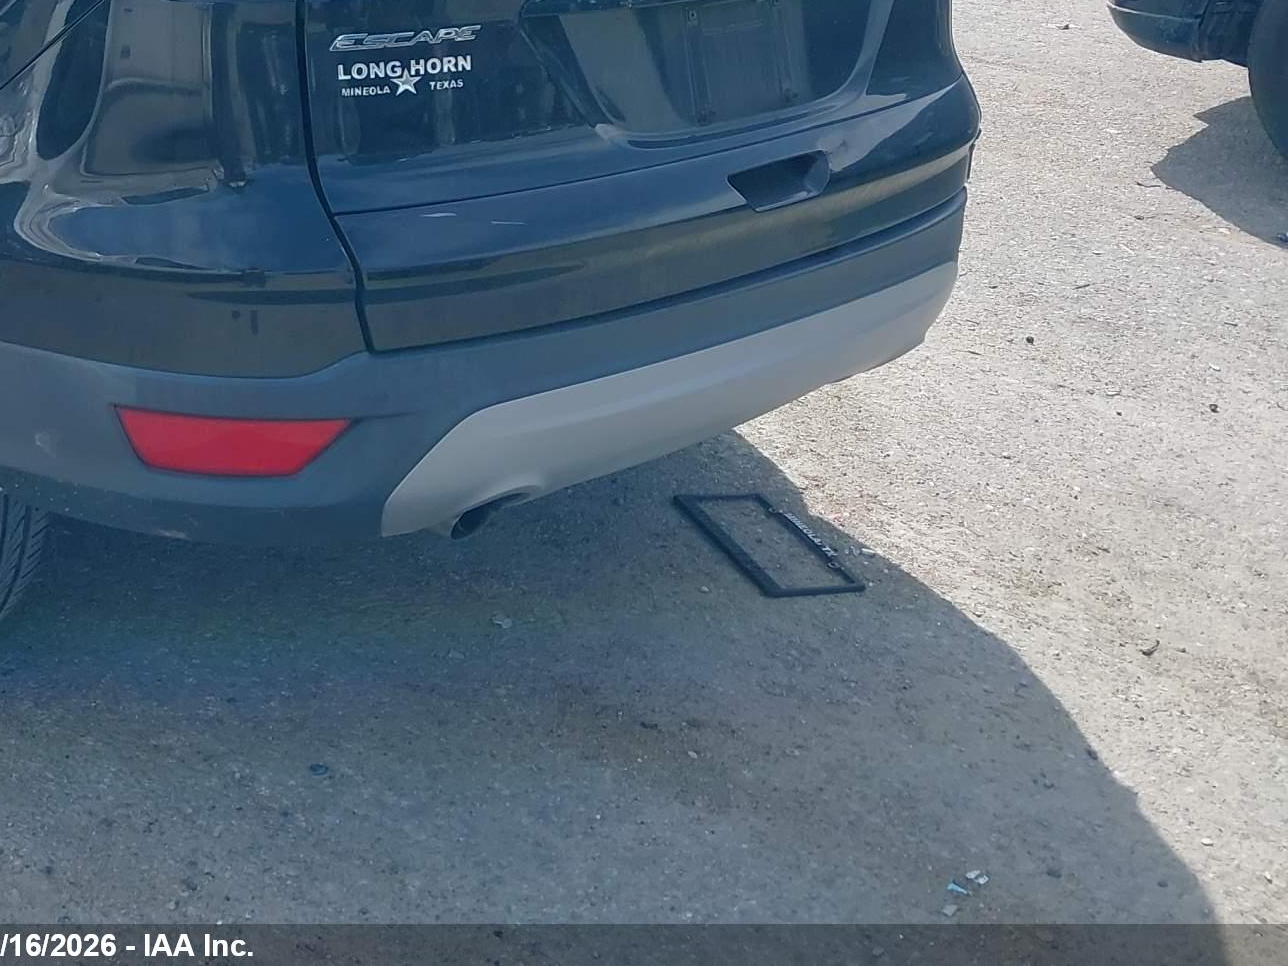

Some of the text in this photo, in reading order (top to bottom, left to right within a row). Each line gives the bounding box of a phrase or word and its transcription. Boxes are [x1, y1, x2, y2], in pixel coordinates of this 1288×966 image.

[329, 24, 482, 52] ESCAPE
[337, 55, 472, 81] LONG HORN
[341, 79, 464, 97] MINEOLA TEXAS
